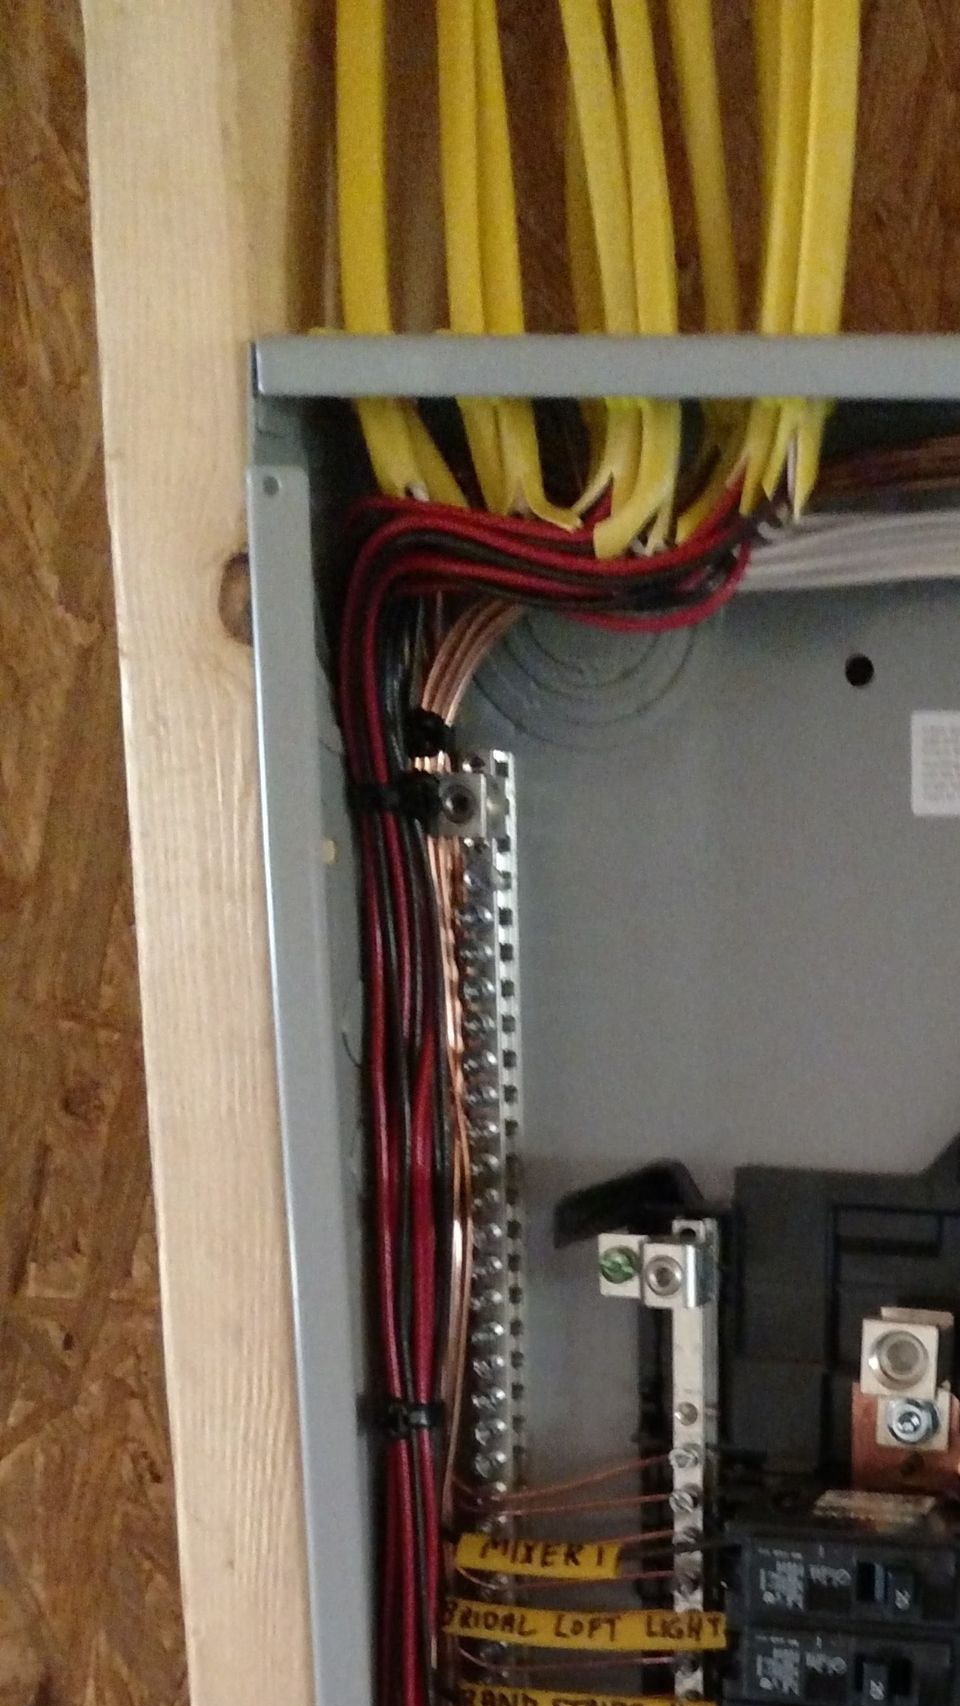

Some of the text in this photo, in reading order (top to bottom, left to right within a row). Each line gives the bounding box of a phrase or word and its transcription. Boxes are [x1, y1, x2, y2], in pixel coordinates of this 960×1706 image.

[480, 1540, 581, 1567] MIXER
[553, 1615, 622, 1642] LOFT
[645, 1614, 723, 1642] LIGHT
